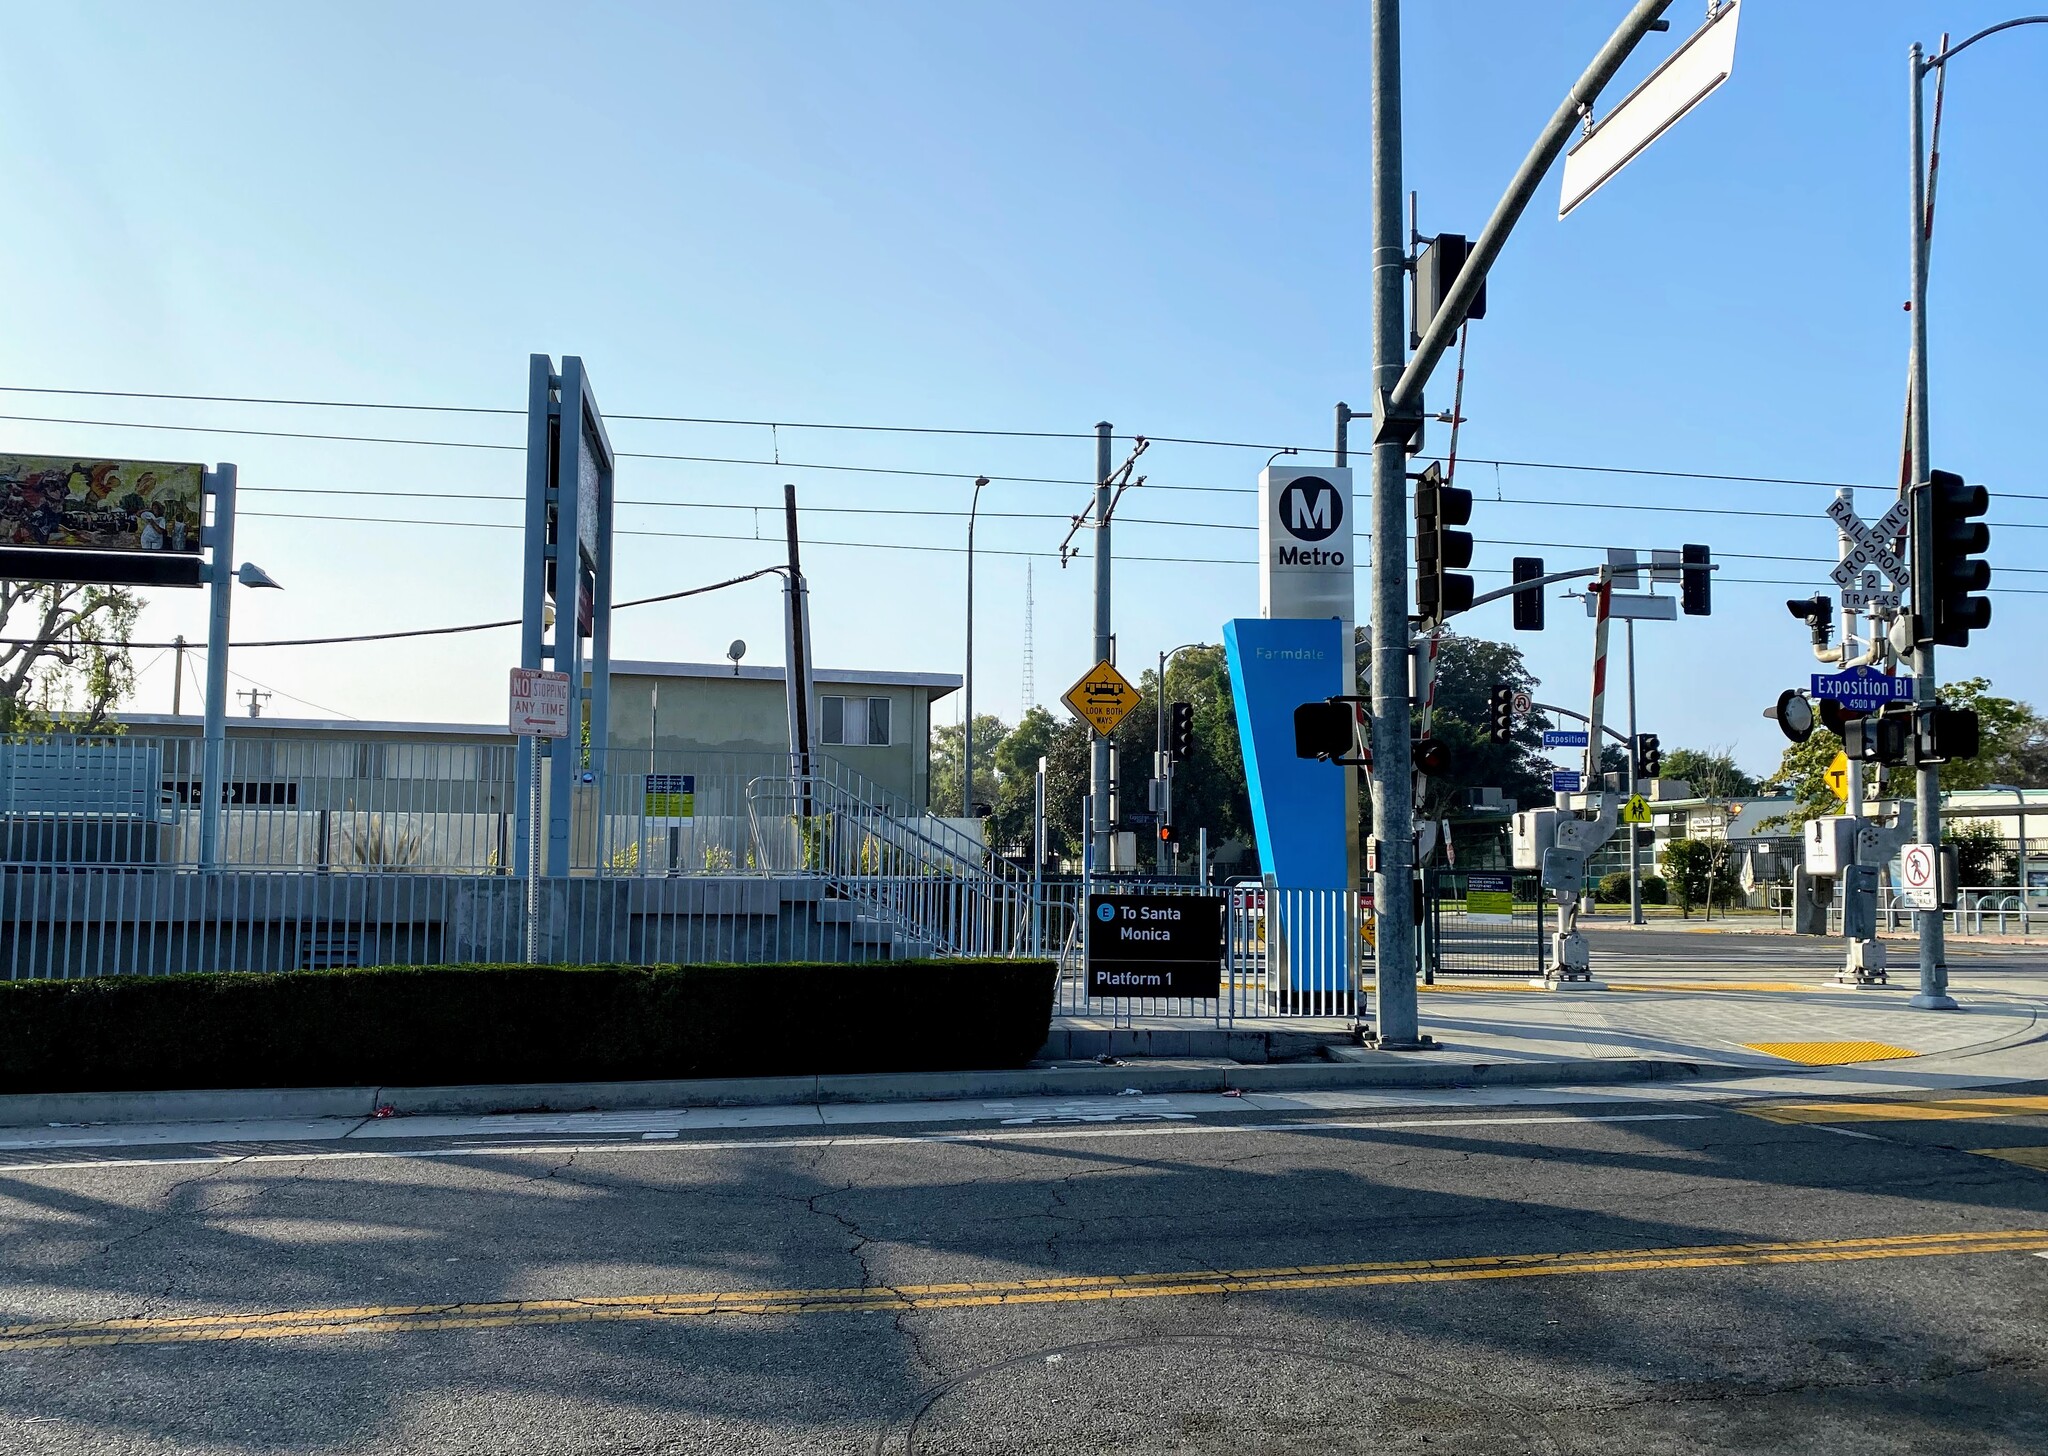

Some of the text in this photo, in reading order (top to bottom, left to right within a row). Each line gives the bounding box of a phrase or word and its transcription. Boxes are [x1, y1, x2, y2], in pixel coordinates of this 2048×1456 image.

[1831, 501, 1910, 586] RAIL ROAD
[1835, 504, 1909, 584] CROSSING
[1279, 545, 1345, 566] Metro
[1866, 574, 1876, 588] 2
[1256, 647, 1325, 660] Farmdale
[513, 678, 567, 699] NO STOPPING
[1818, 676, 1907, 697] Exposition Bl
[515, 701, 565, 716] ANY TIME
[1849, 699, 1877, 709] 4500 W
[1085, 707, 1123, 716] LOOK BOTH
[1096, 717, 1113, 725] WAYS
[1545, 734, 1587, 745] Exposition
[1102, 906, 1181, 920] E To Santa
[1120, 927, 1171, 940] Monica
[1097, 971, 1172, 985] Platform 1
